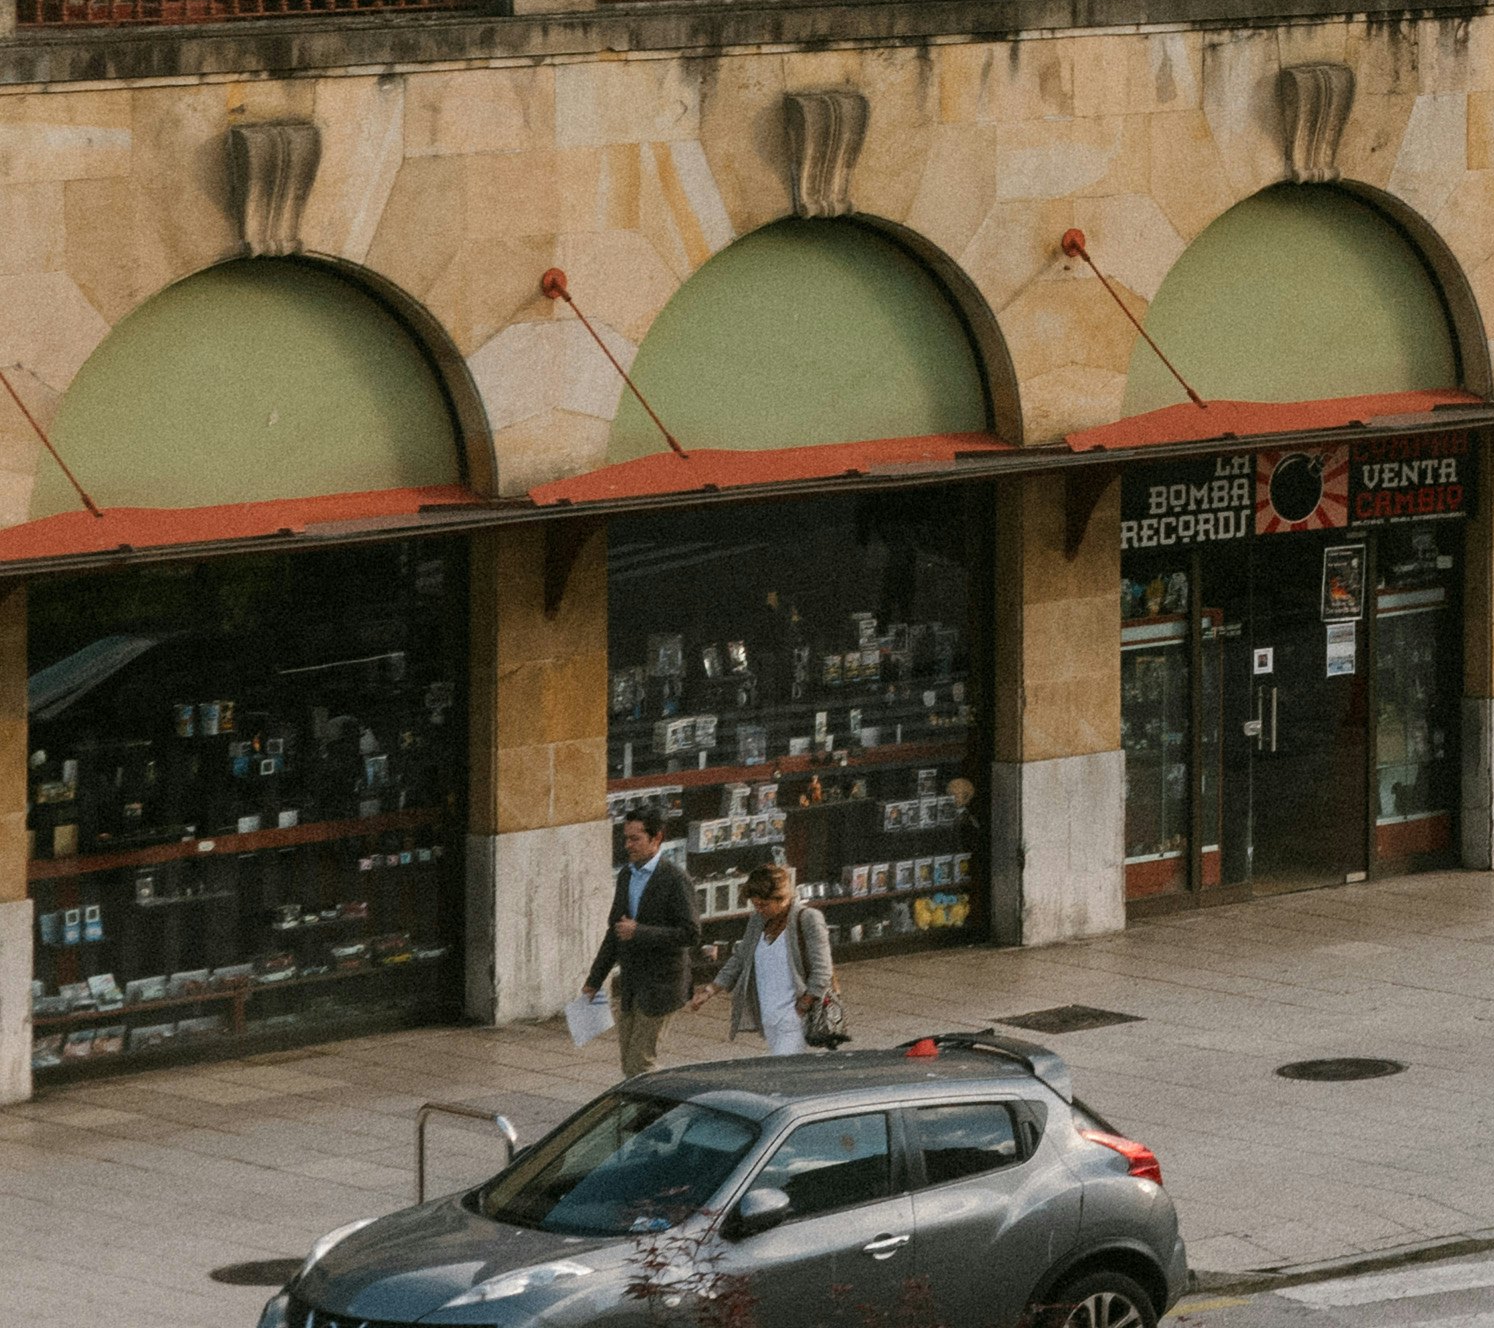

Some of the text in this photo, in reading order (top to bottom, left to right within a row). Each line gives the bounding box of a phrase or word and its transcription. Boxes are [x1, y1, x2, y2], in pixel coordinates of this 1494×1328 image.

[1362, 457, 1459, 490] VENTA
[1149, 478, 1251, 515] BOMBA
[1355, 484, 1464, 520] CAMBIO
[1120, 509, 1251, 550] RECORDS
